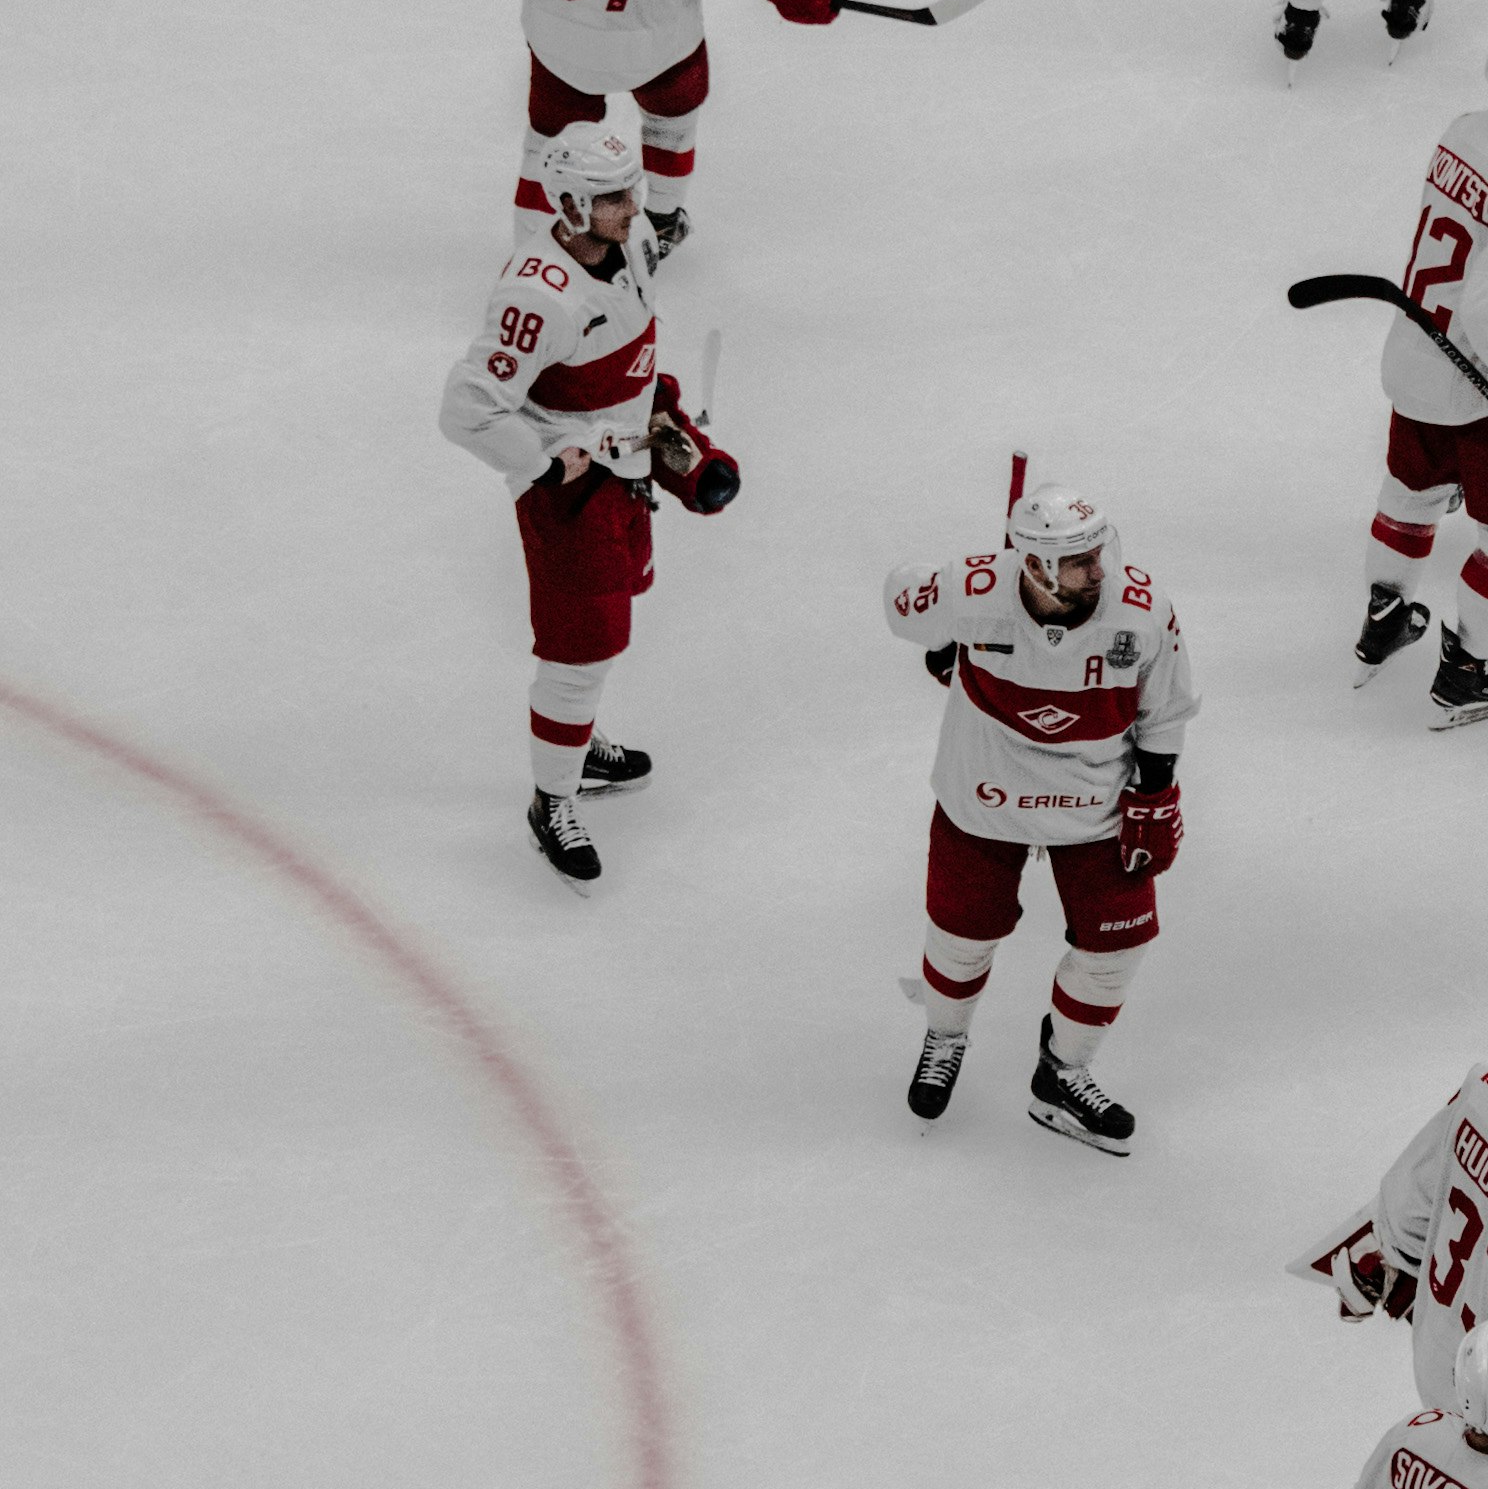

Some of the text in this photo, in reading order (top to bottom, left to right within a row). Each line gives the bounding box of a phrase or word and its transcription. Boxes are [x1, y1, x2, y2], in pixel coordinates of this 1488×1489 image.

[517, 257, 569, 293] BQ
[1403, 204, 1474, 337] 12
[500, 306, 544, 354] 98
[965, 554, 997, 596] BQ
[1084, 655, 1103, 687] A
[1017, 794, 1104, 809] ERIELL
[1099, 911, 1153, 931] BAUER
